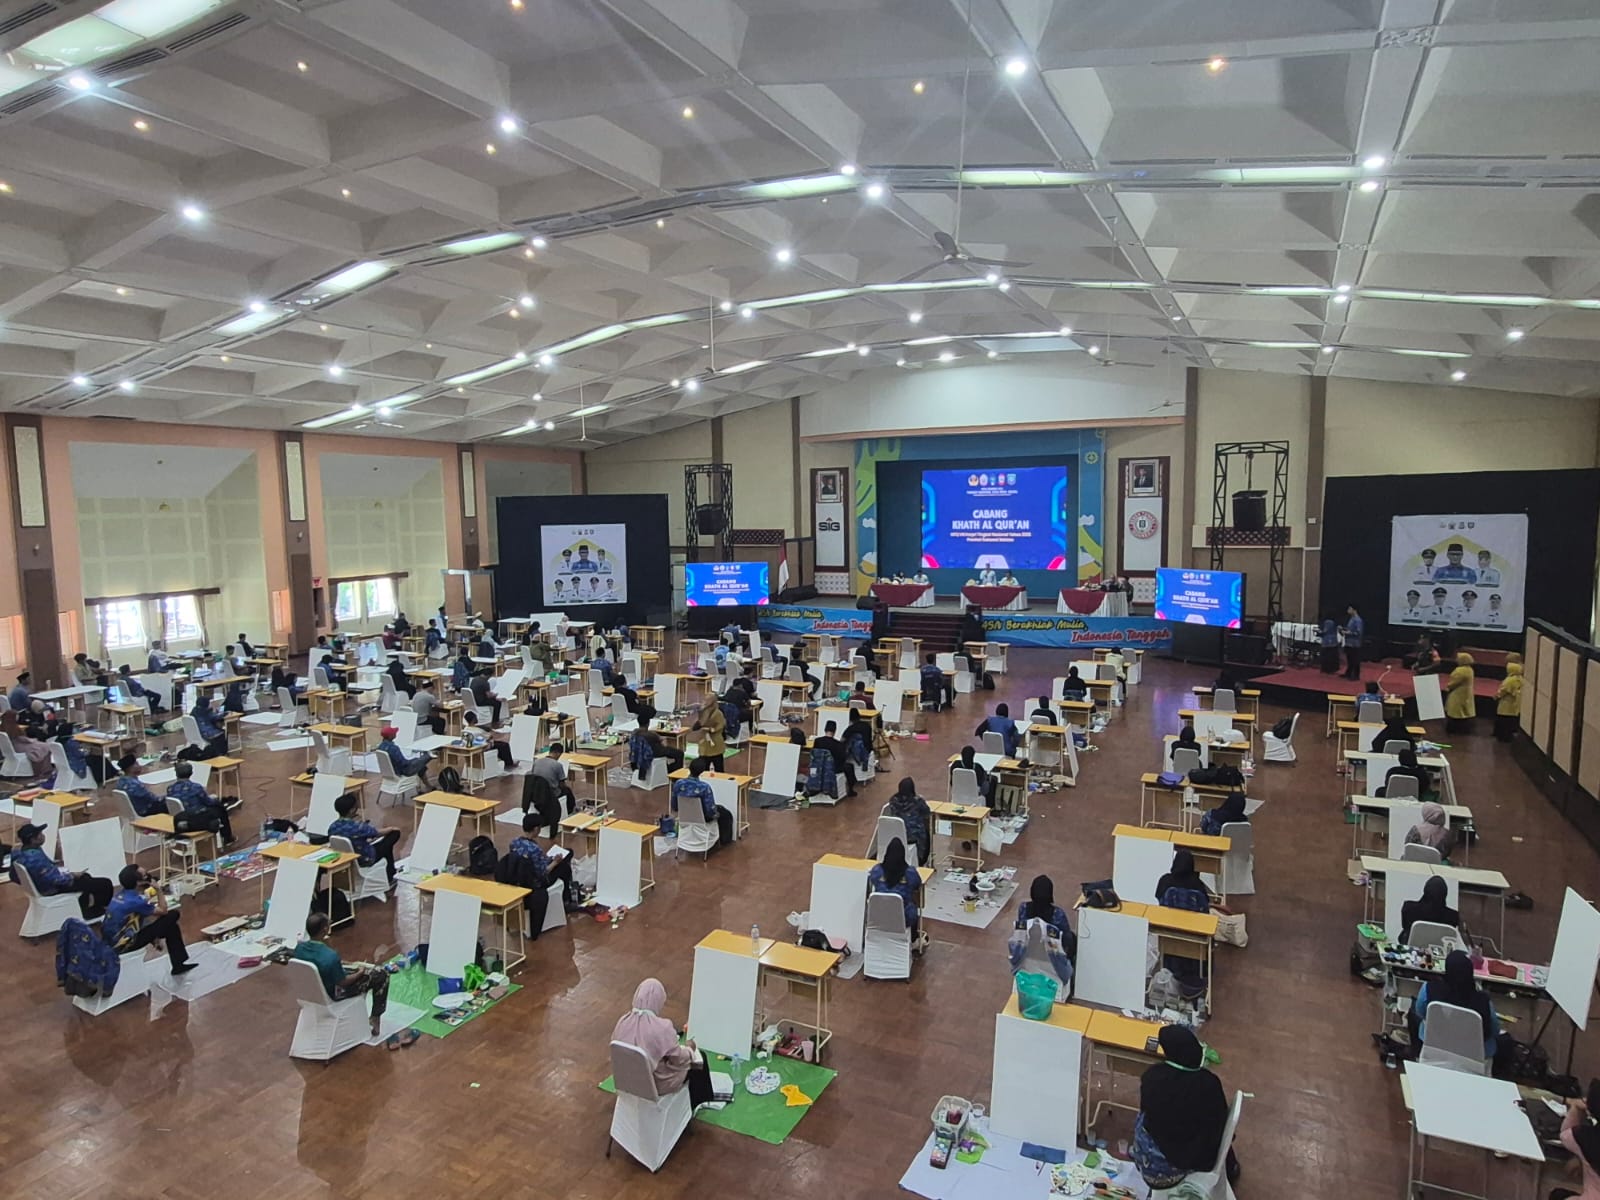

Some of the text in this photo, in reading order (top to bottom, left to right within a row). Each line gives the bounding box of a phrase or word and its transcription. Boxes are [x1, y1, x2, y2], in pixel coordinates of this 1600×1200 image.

[972, 509, 1008, 519] CABANG
[818, 521, 841, 532] SIG
[952, 520, 1030, 531] KHATH AL QUR'AN
[1072, 630, 1123, 643] Indonesia
